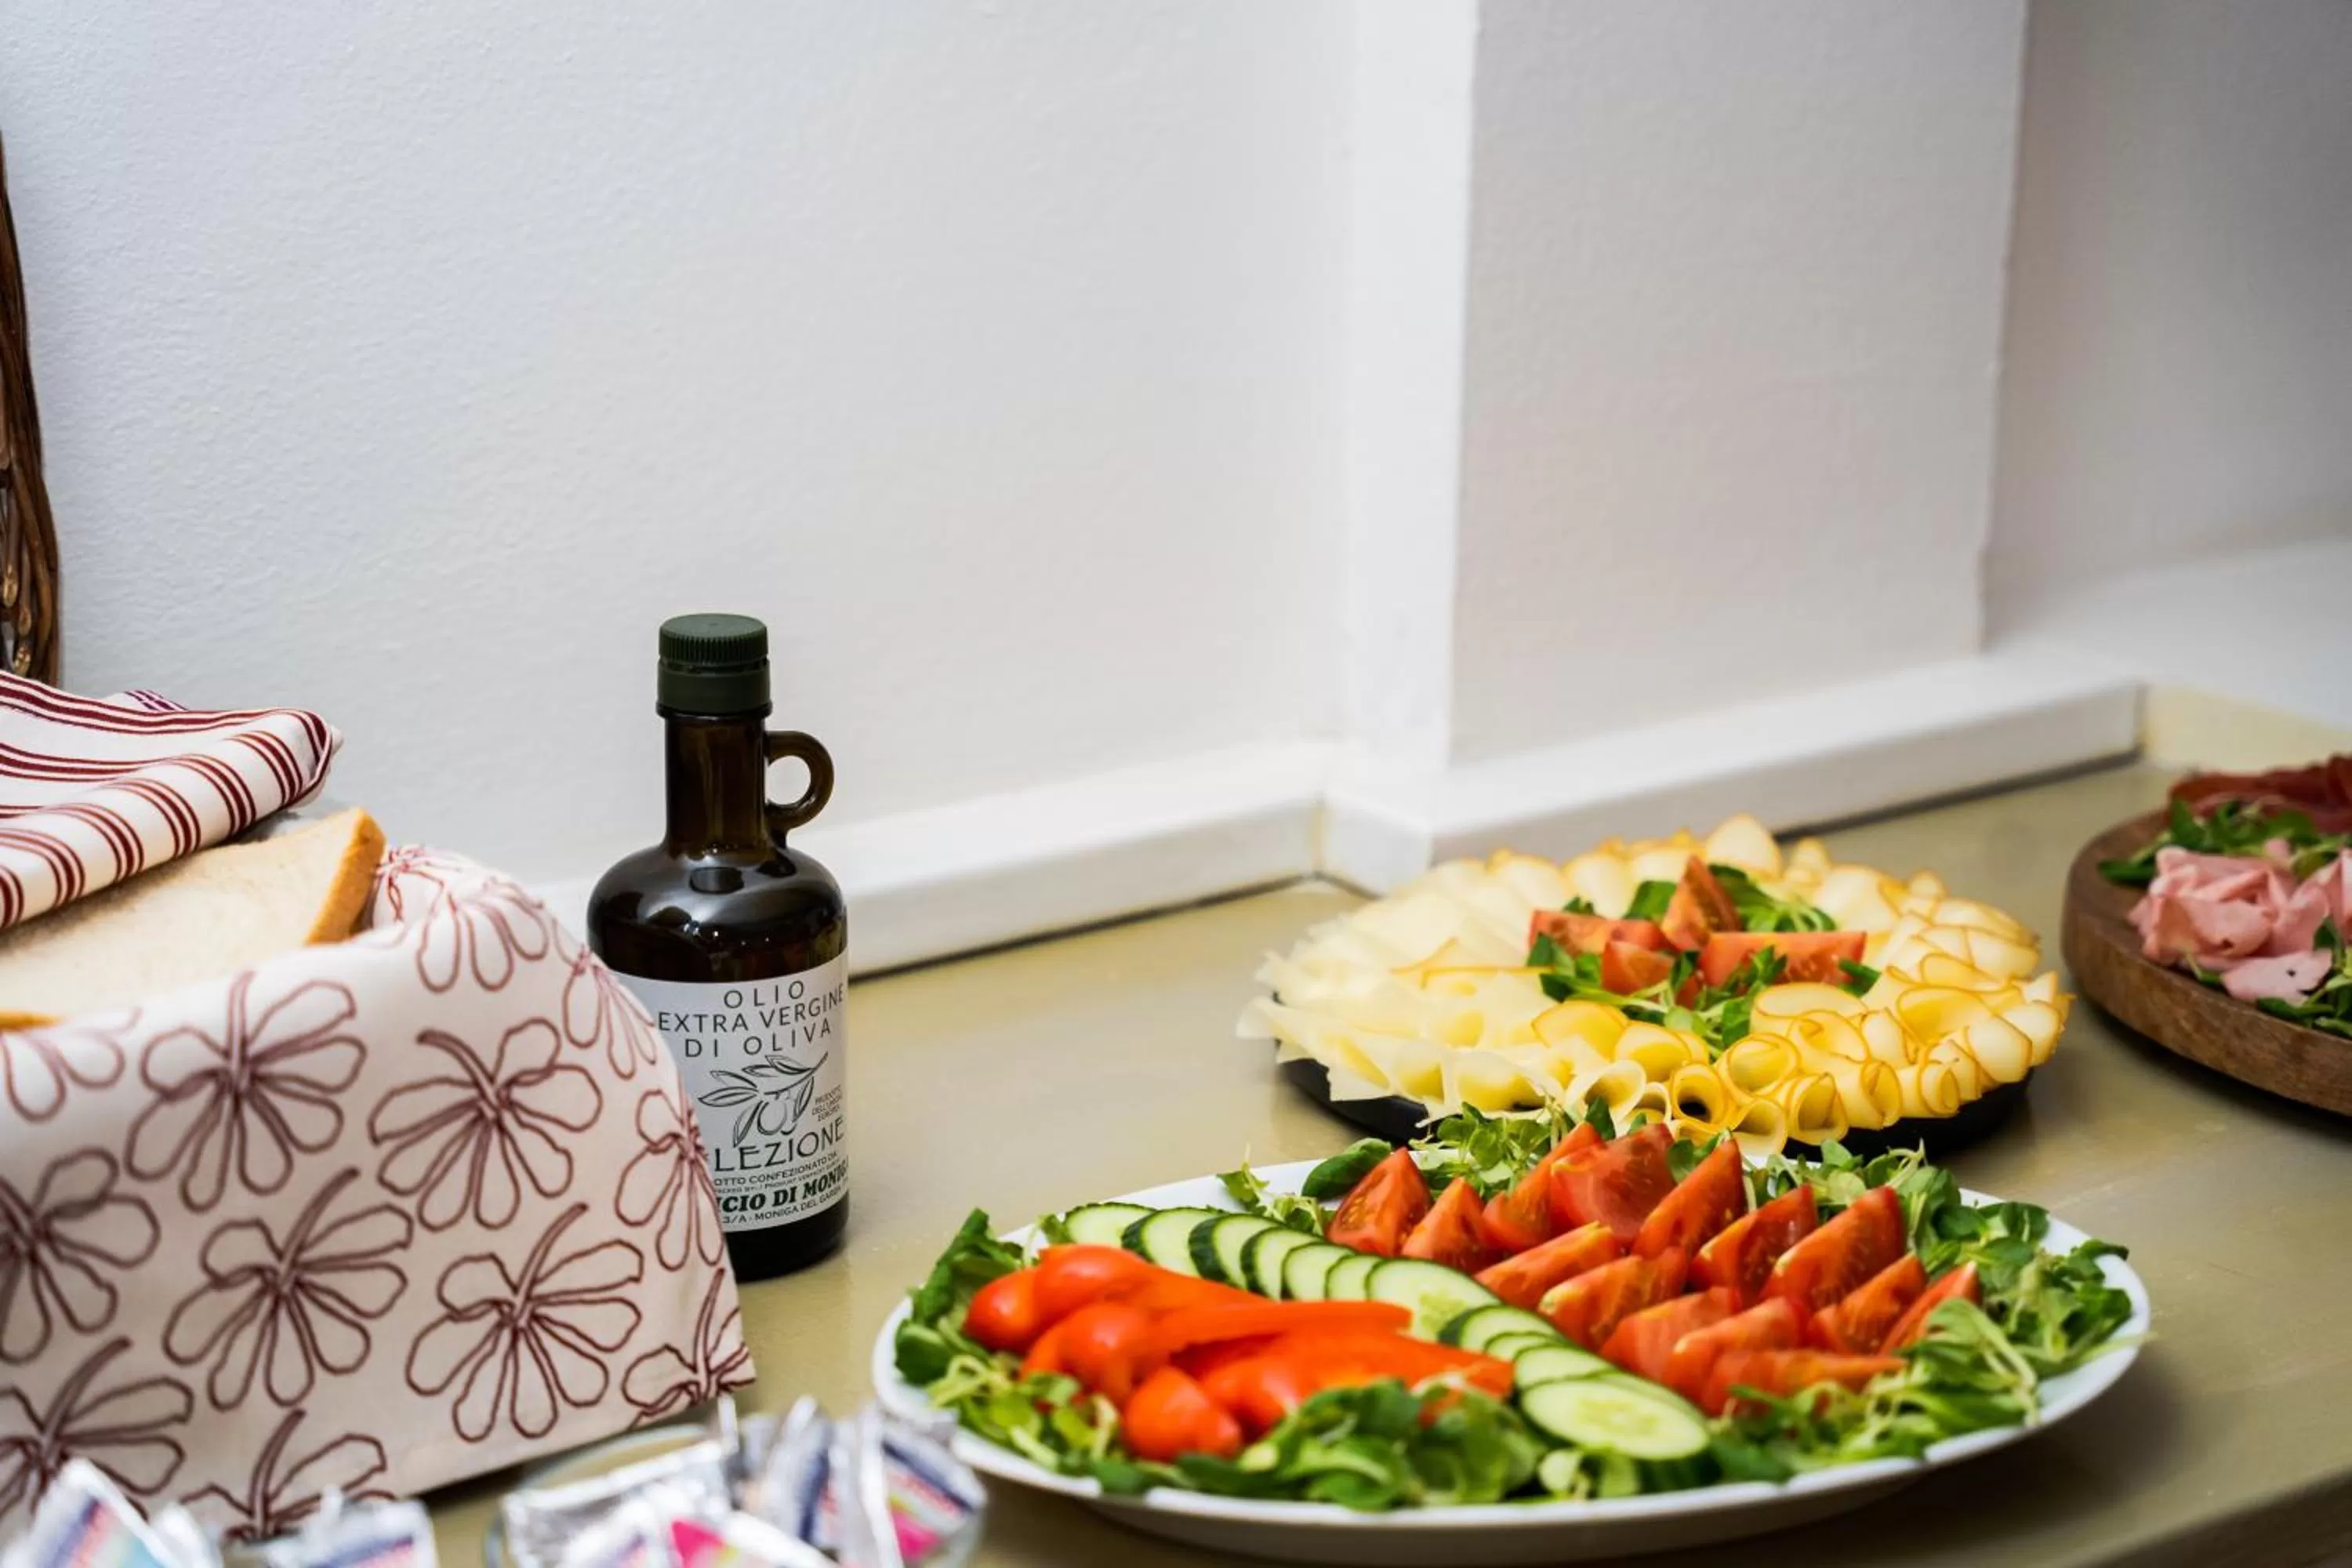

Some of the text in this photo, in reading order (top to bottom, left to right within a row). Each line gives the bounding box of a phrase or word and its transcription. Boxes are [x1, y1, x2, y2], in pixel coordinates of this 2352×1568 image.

[659, 982, 844, 1033] EXTRA VERGINE
[723, 980, 804, 1010] OLIO
[685, 1017, 831, 1058] DI OLIVA
[714, 1116, 845, 1172] LEZIONE
[713, 1177, 747, 1186] OTTO
[749, 1156, 827, 1184] CONFEZIONATO
[771, 1185, 797, 1207] DI
